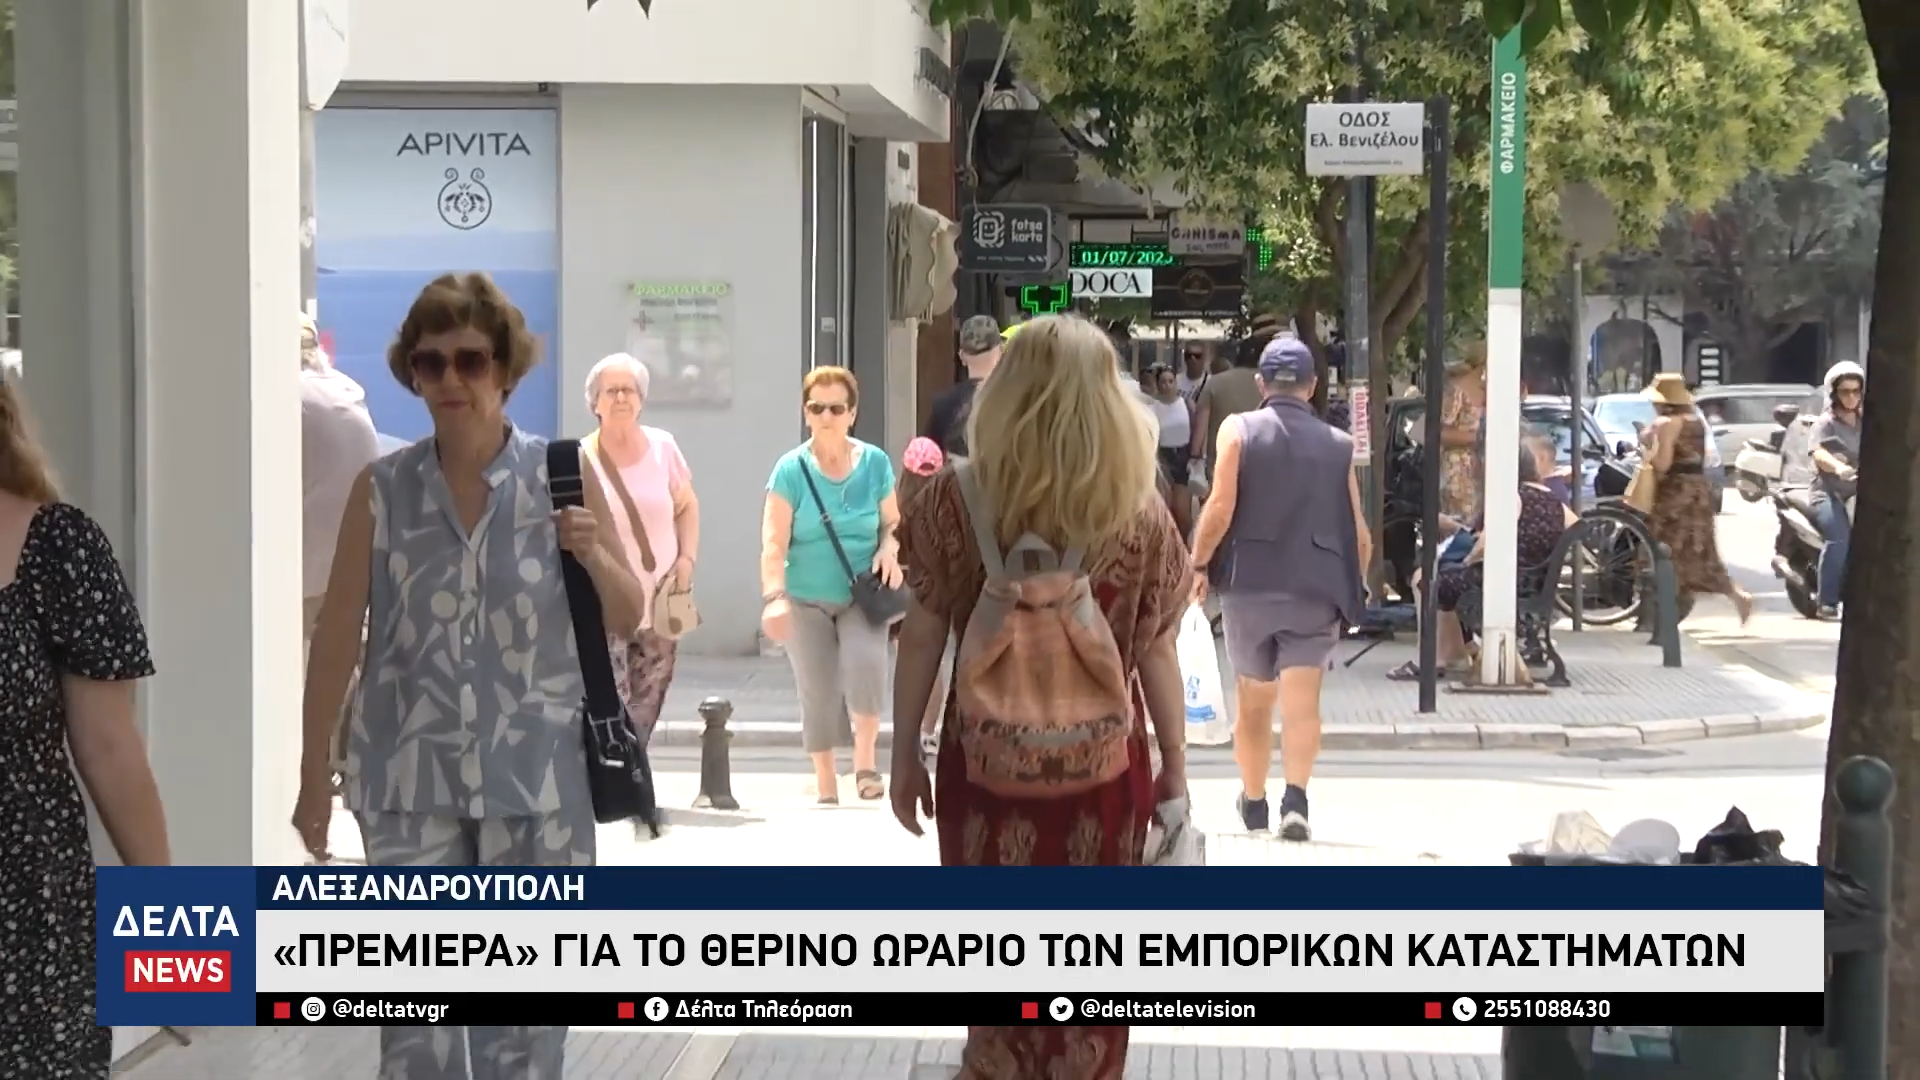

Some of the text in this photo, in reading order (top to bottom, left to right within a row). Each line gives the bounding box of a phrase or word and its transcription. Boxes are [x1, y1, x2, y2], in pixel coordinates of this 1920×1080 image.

[1338, 111, 1390, 127] ΟΔΟΣ
[1500, 72, 1516, 174] ΦΑΡΜΑΚΕΙΟ
[396, 132, 531, 156] APIVITA
[1310, 131, 1419, 149] Ελ. Βενιζέλου
[1069, 271, 1143, 294] DOCA
